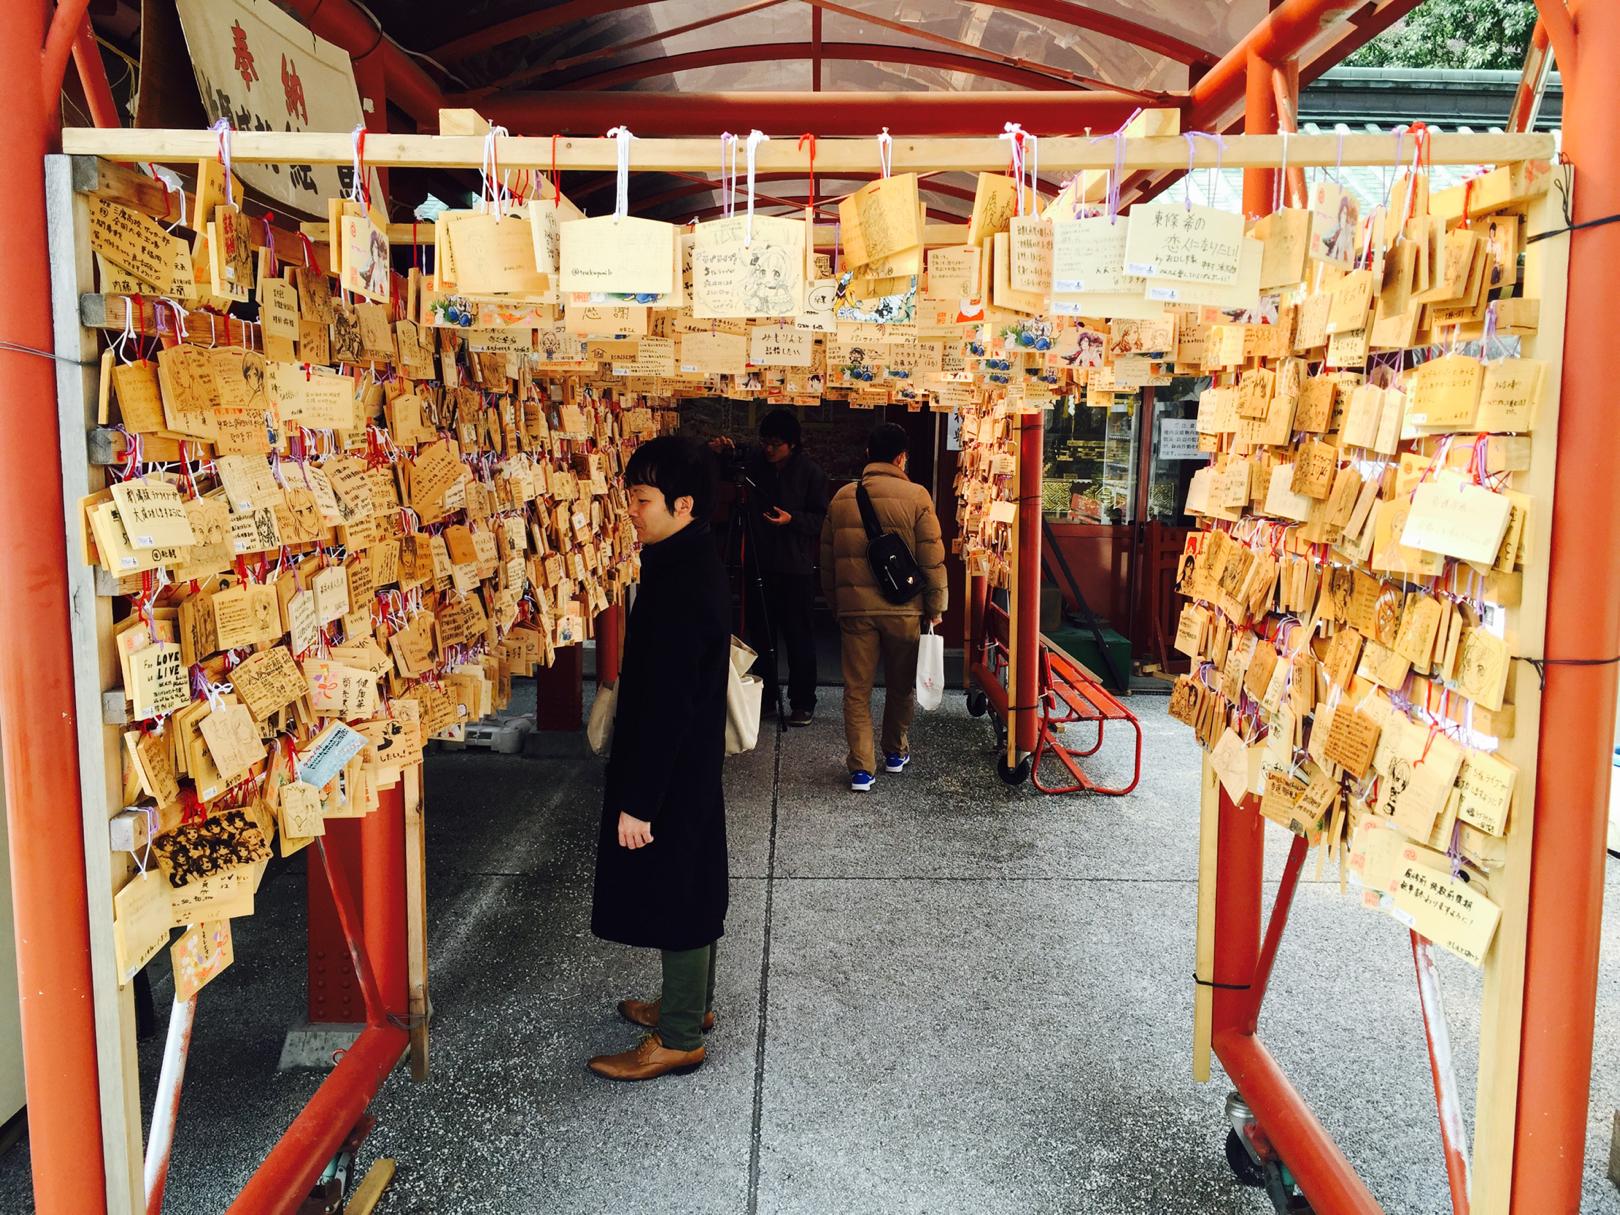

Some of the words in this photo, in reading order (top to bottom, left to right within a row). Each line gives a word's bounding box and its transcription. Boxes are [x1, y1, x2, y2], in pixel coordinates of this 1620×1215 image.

[230, 18, 309, 127] 奉納
[157, 651, 180, 666] LOVE
[157, 664, 180, 680] LIVE
